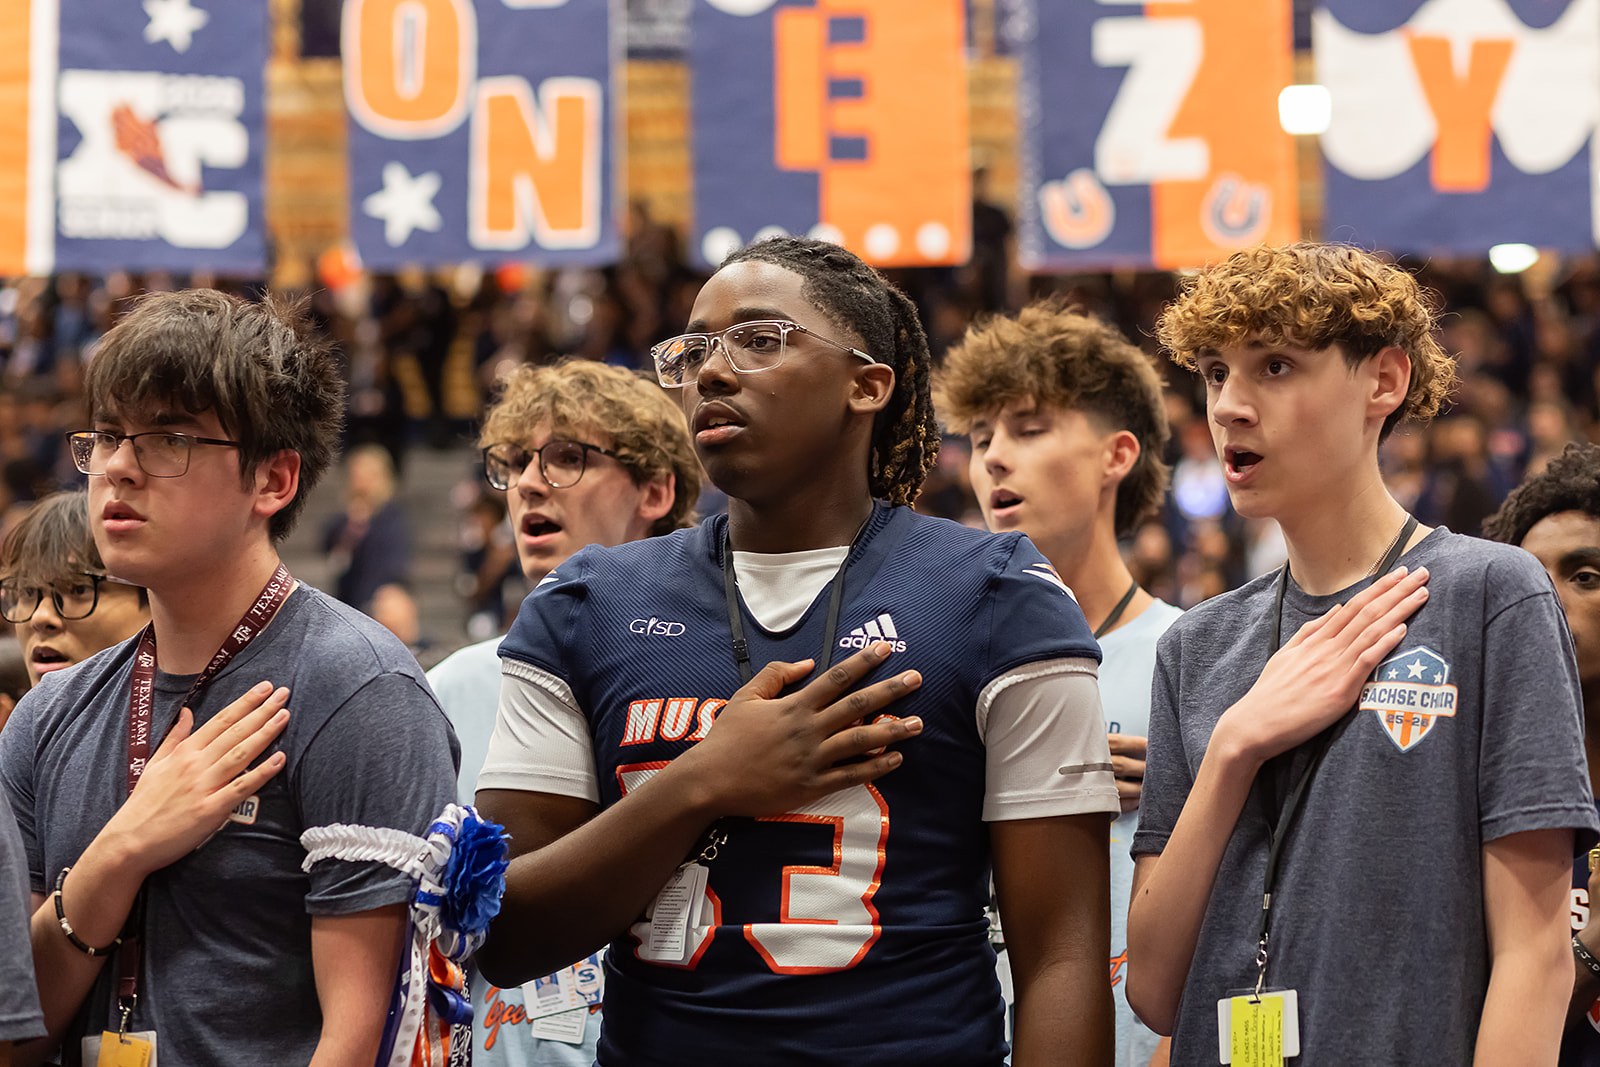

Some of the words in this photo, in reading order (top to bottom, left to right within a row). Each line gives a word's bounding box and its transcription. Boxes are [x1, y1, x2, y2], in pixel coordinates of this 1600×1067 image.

[1091, 17, 1209, 185] Z
[1402, 30, 1516, 193] Y
[250, 580, 281, 617] TEXAS
[138, 677, 152, 716] TEXAS
[1361, 687, 1418, 706] SACHSE
[136, 719, 149, 746] A&M
